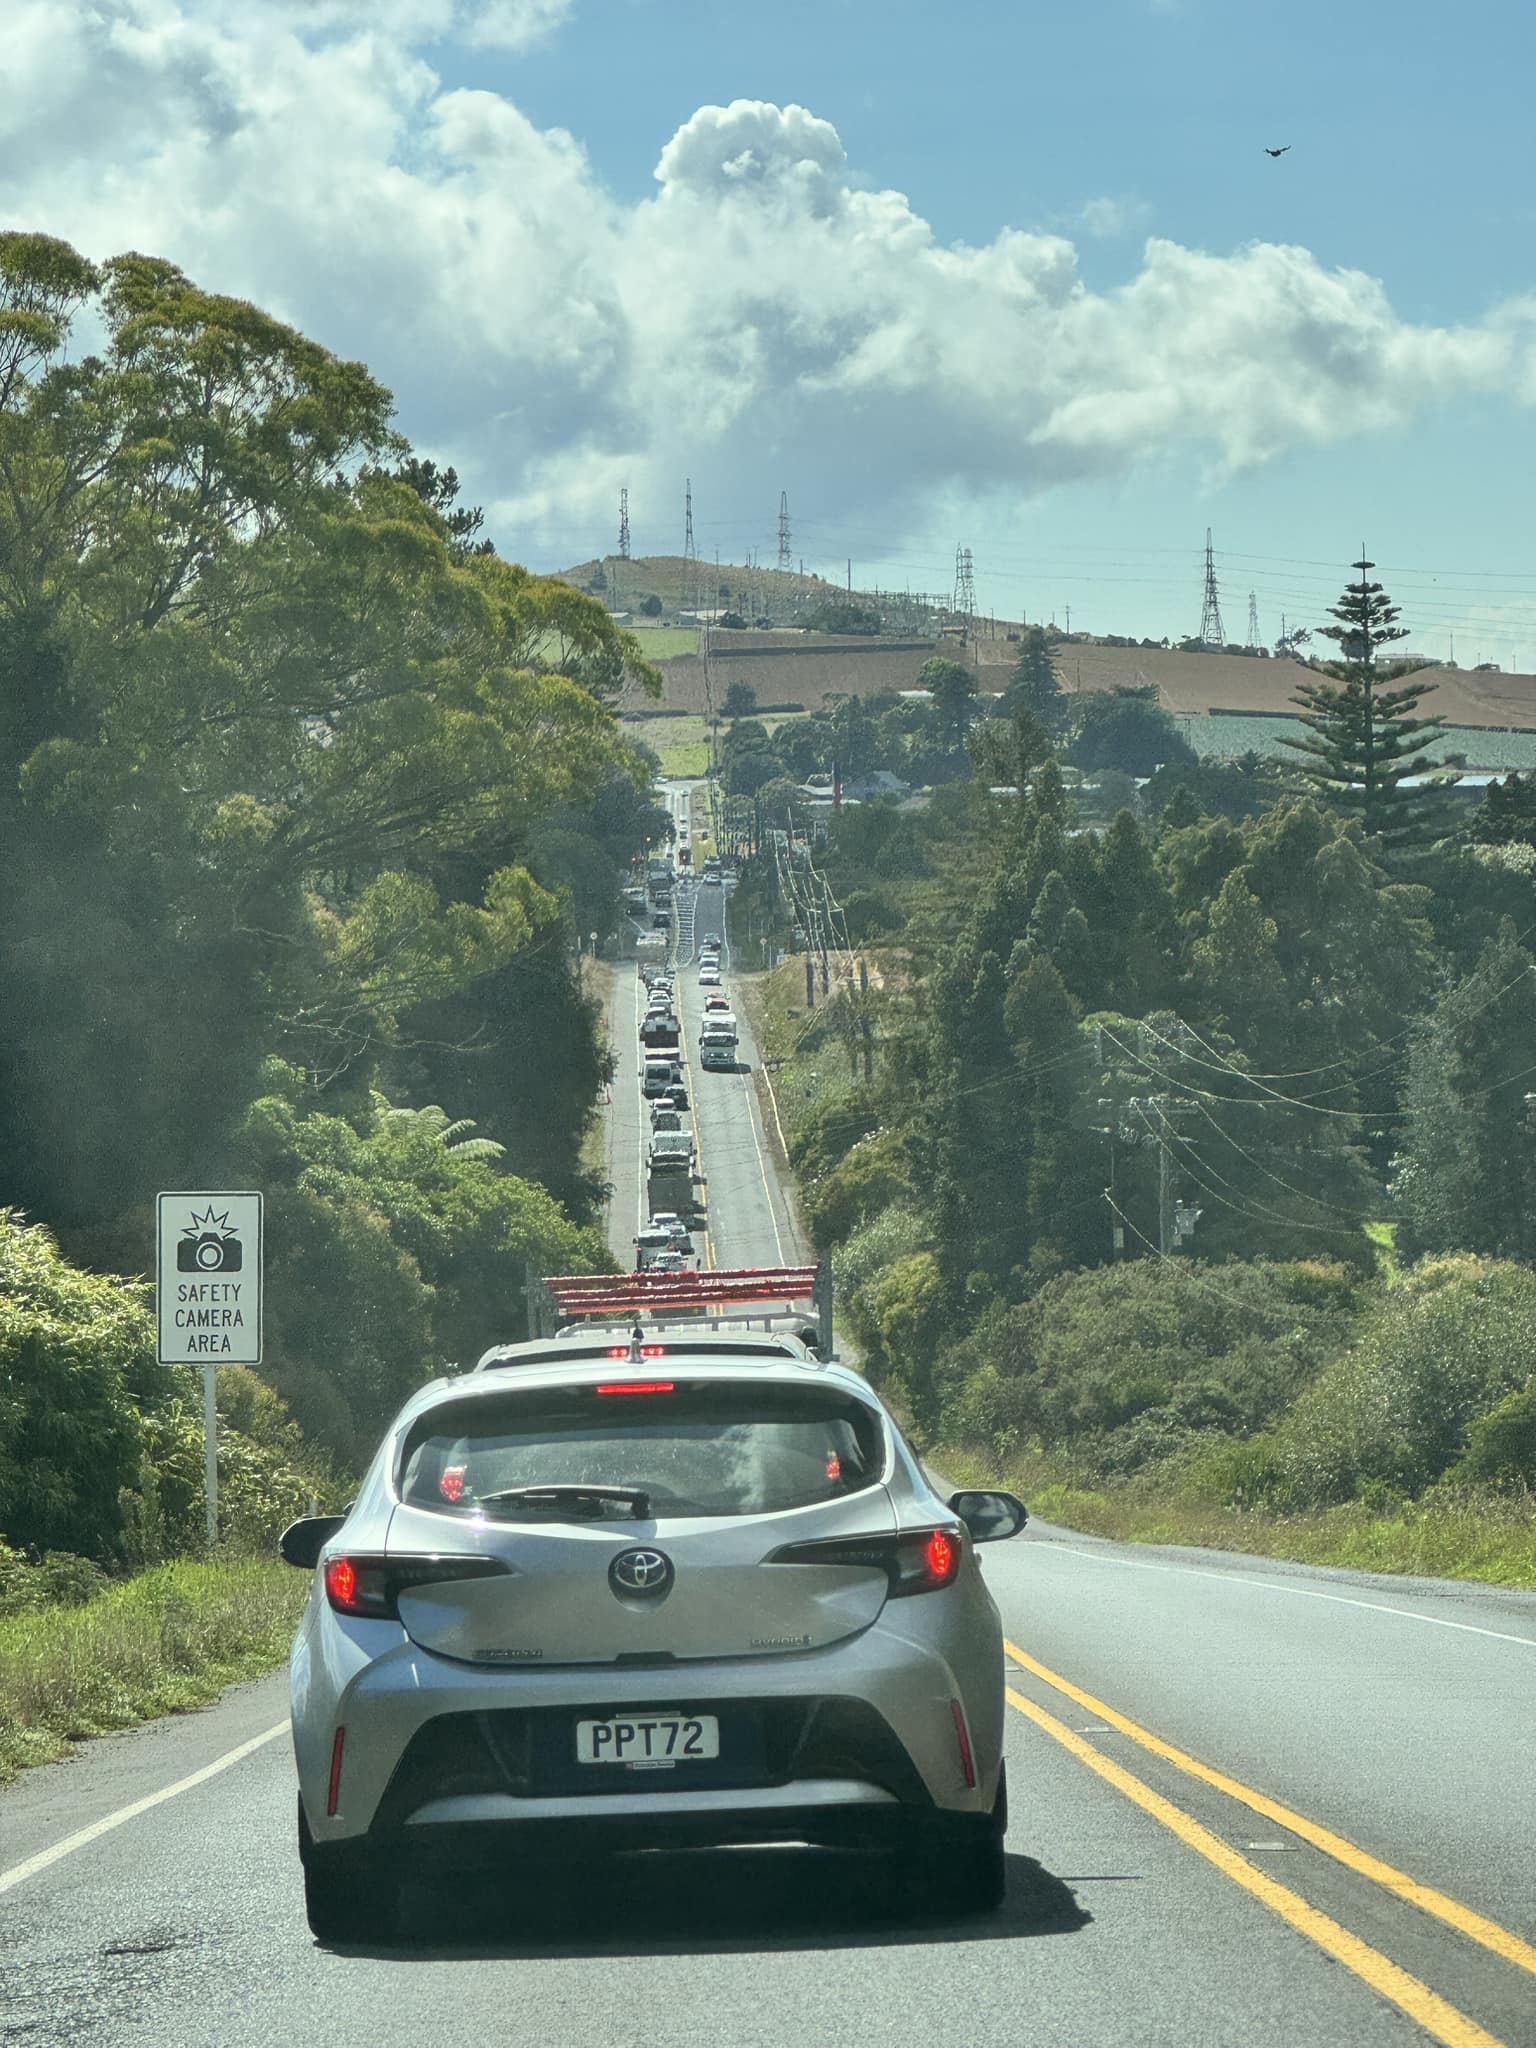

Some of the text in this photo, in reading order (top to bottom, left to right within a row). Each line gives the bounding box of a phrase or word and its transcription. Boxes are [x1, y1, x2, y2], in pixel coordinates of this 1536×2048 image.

[177, 1284, 242, 1302] SAFETY
[175, 1309, 244, 1328] CAMERA
[187, 1334, 232, 1353] AREA
[592, 1721, 704, 1758] PPT72
